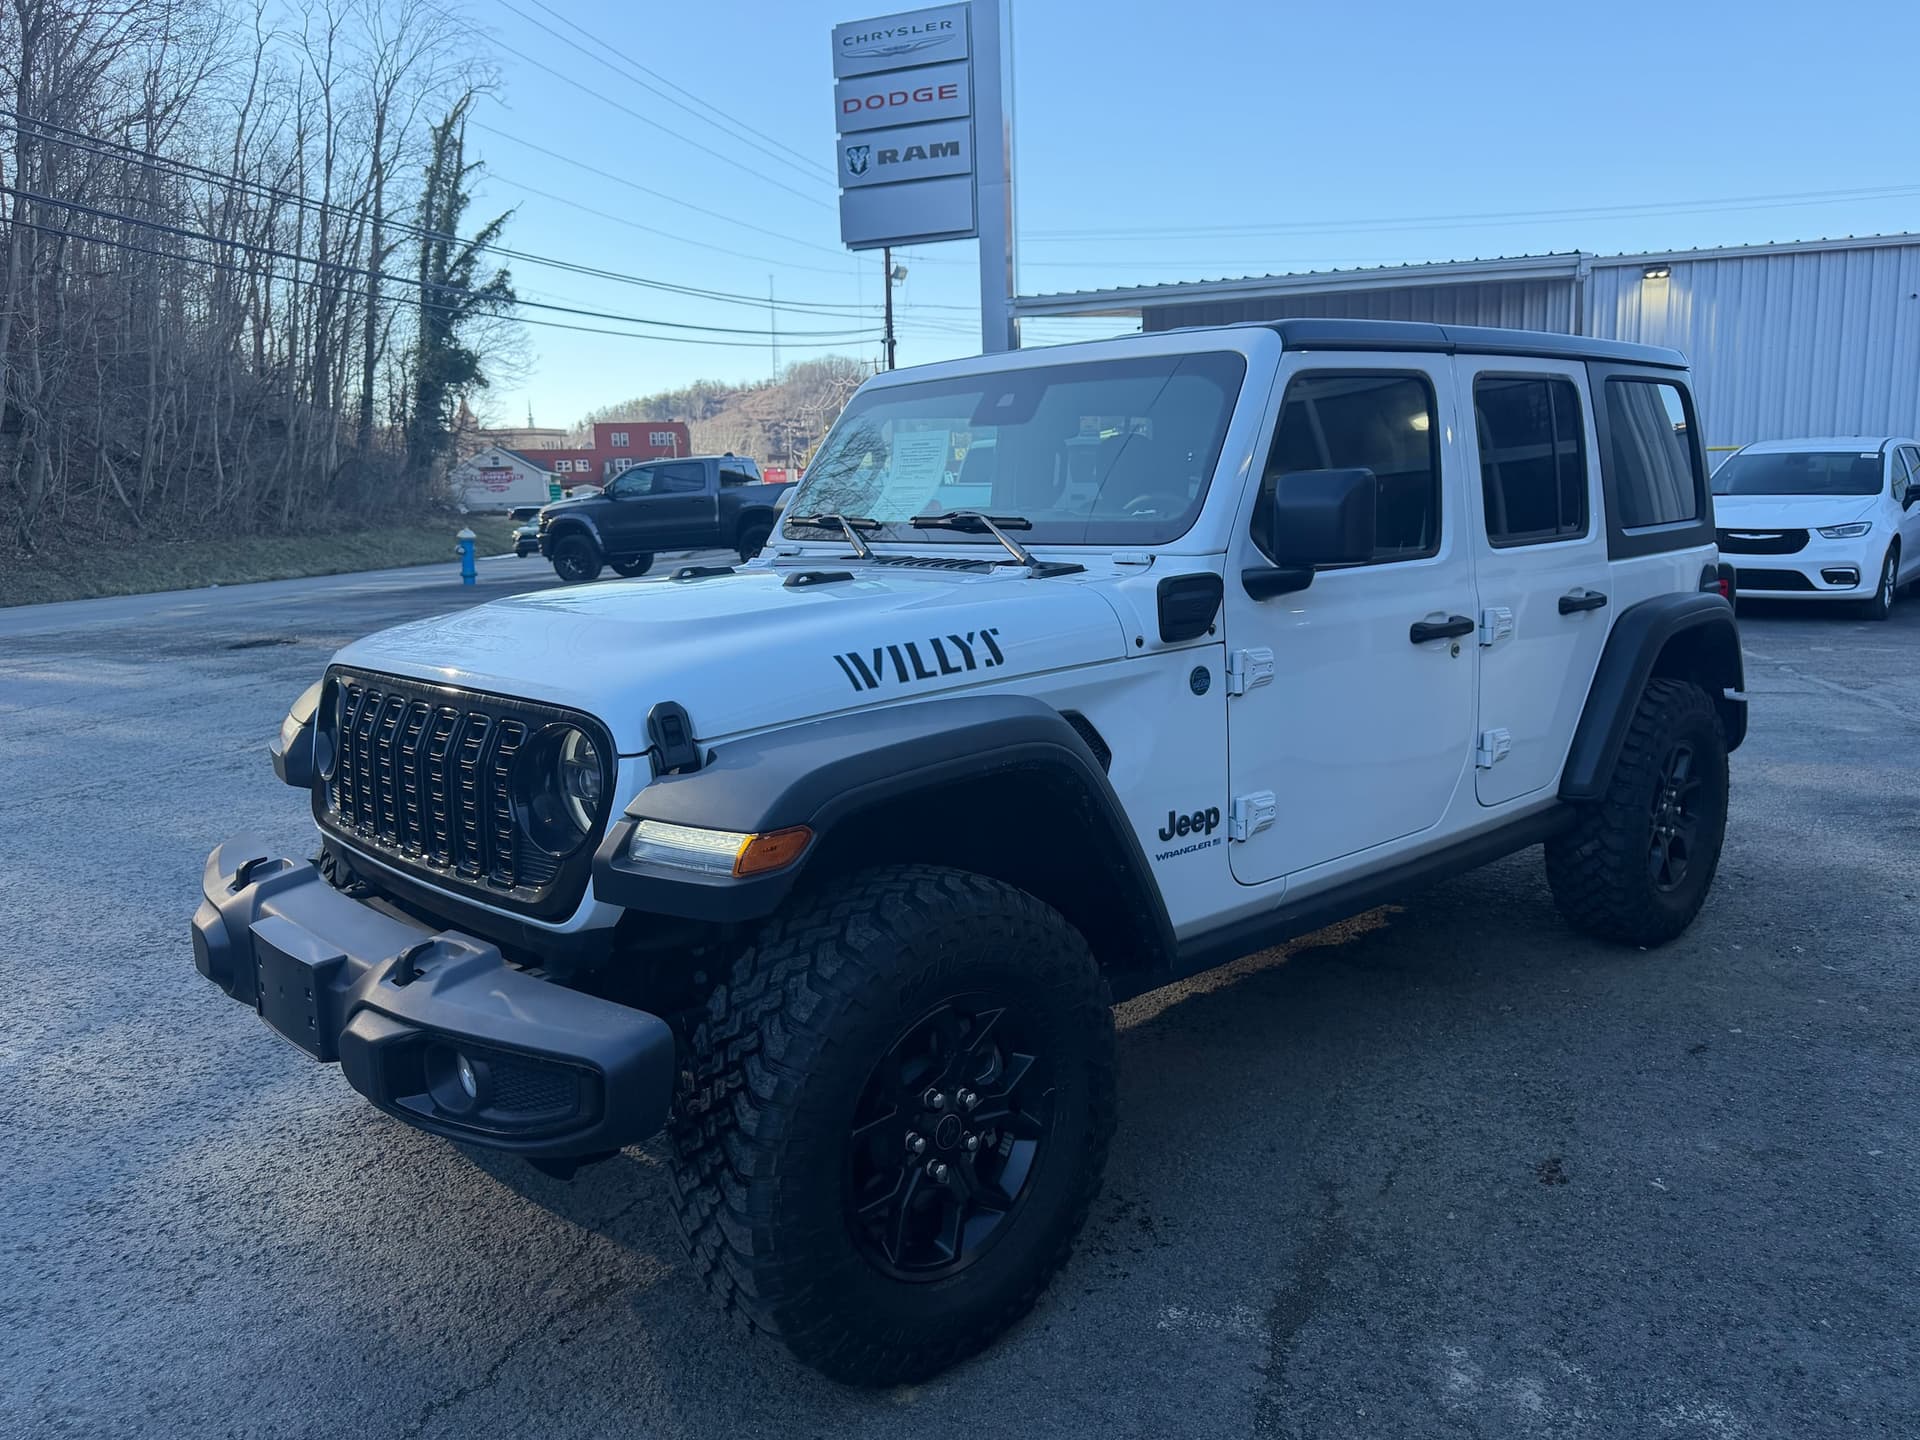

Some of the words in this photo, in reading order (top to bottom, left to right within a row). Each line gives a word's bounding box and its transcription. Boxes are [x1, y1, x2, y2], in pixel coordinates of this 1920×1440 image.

[843, 20, 953, 47] CHRYSLER
[843, 83, 959, 114] DODGE
[877, 141, 960, 165] RAM
[833, 628, 1005, 692] WILLYS
[1159, 807, 1220, 841] Jeep
[1156, 841, 1212, 861] WRANGLER
